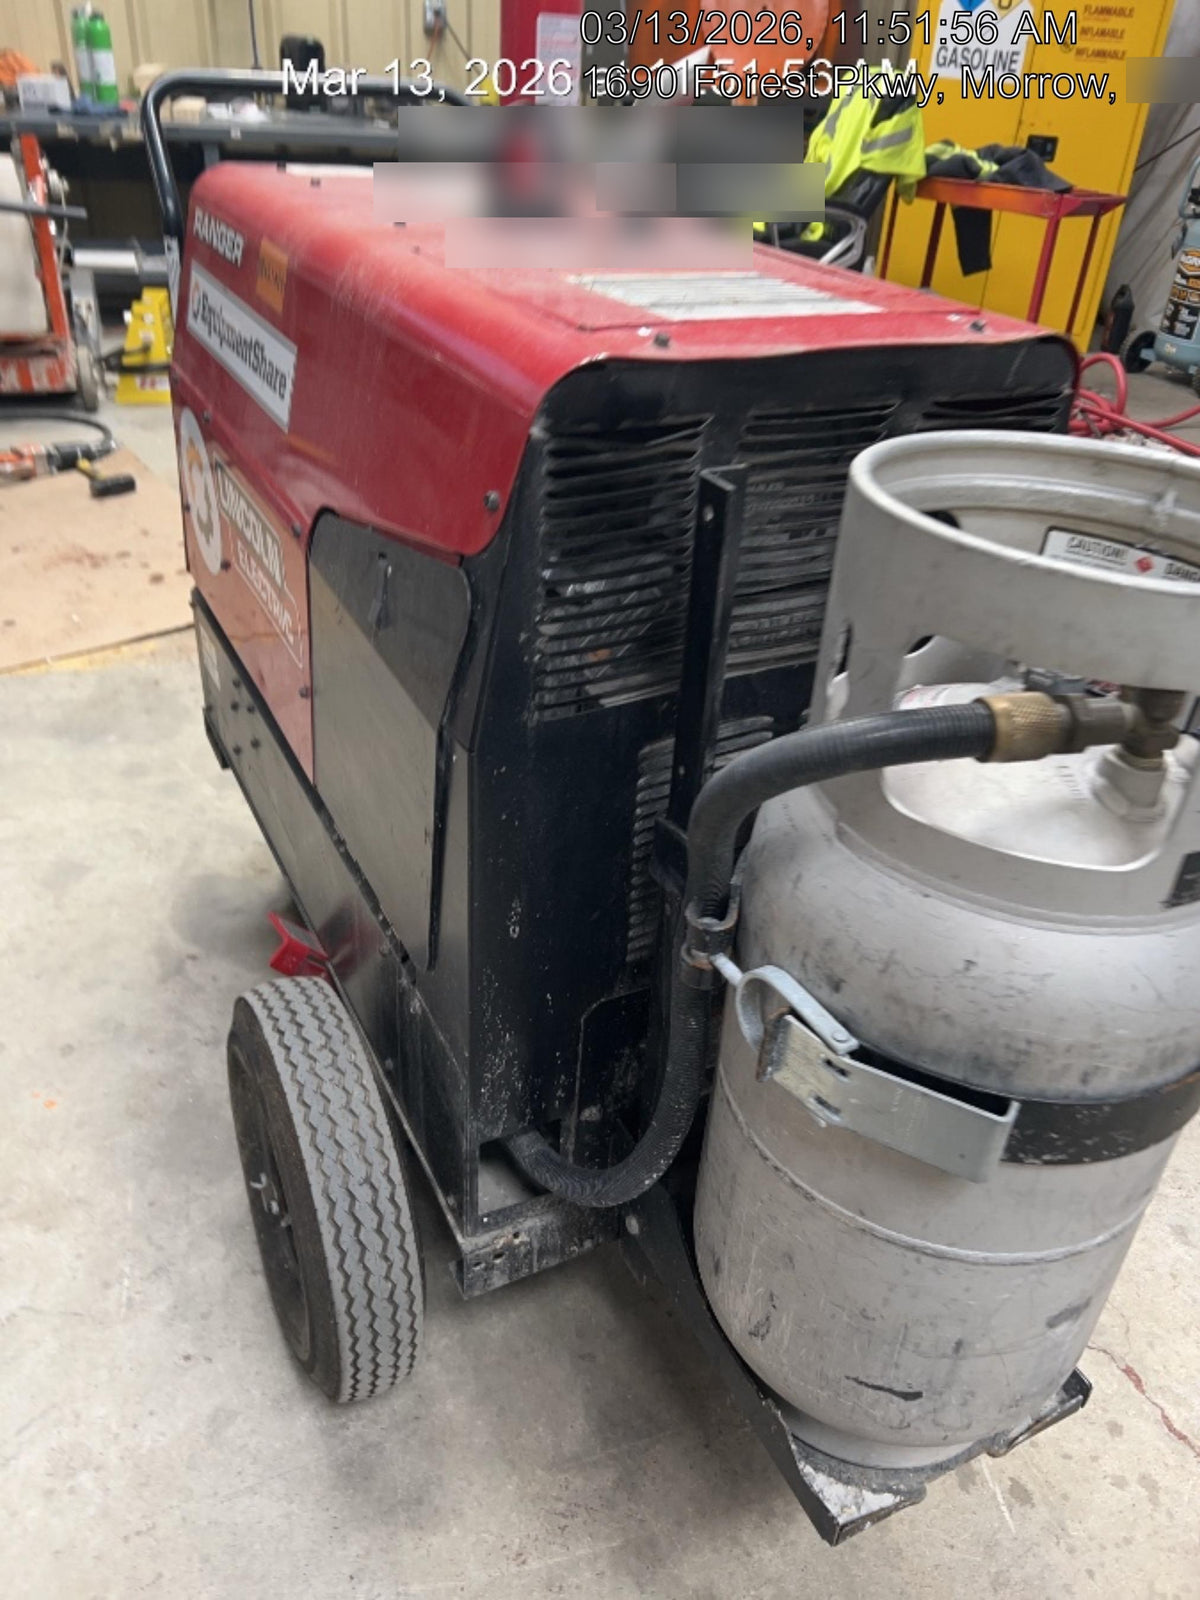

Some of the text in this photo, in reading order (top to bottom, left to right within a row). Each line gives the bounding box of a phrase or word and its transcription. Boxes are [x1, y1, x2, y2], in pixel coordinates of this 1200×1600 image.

[936, 45, 1021, 73] GASOLINE
[193, 206, 245, 269] RANGER
[201, 291, 288, 401] EquipmentShare
